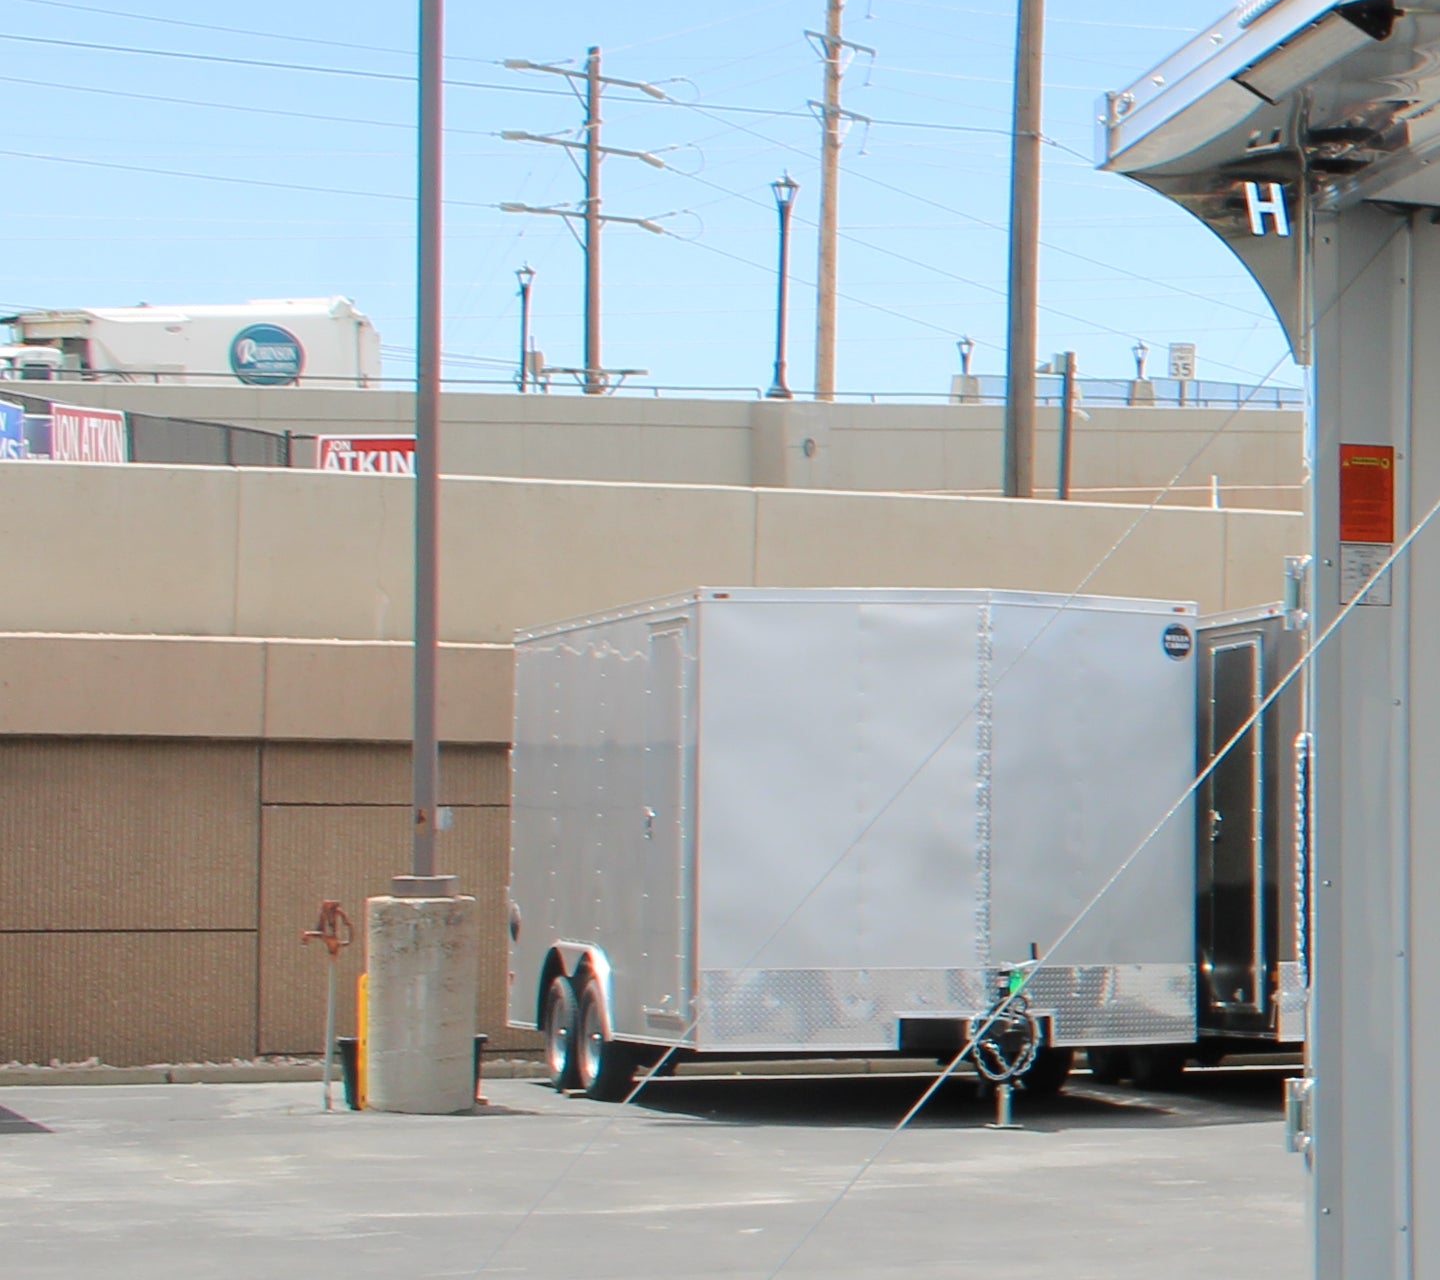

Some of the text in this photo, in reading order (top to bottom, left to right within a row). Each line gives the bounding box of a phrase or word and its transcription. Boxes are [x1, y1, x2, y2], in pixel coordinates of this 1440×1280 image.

[1243, 180, 1290, 237] H
[1170, 362, 1193, 377] 35
[328, 440, 352, 451] JON
[324, 450, 416, 474] ATKIN
